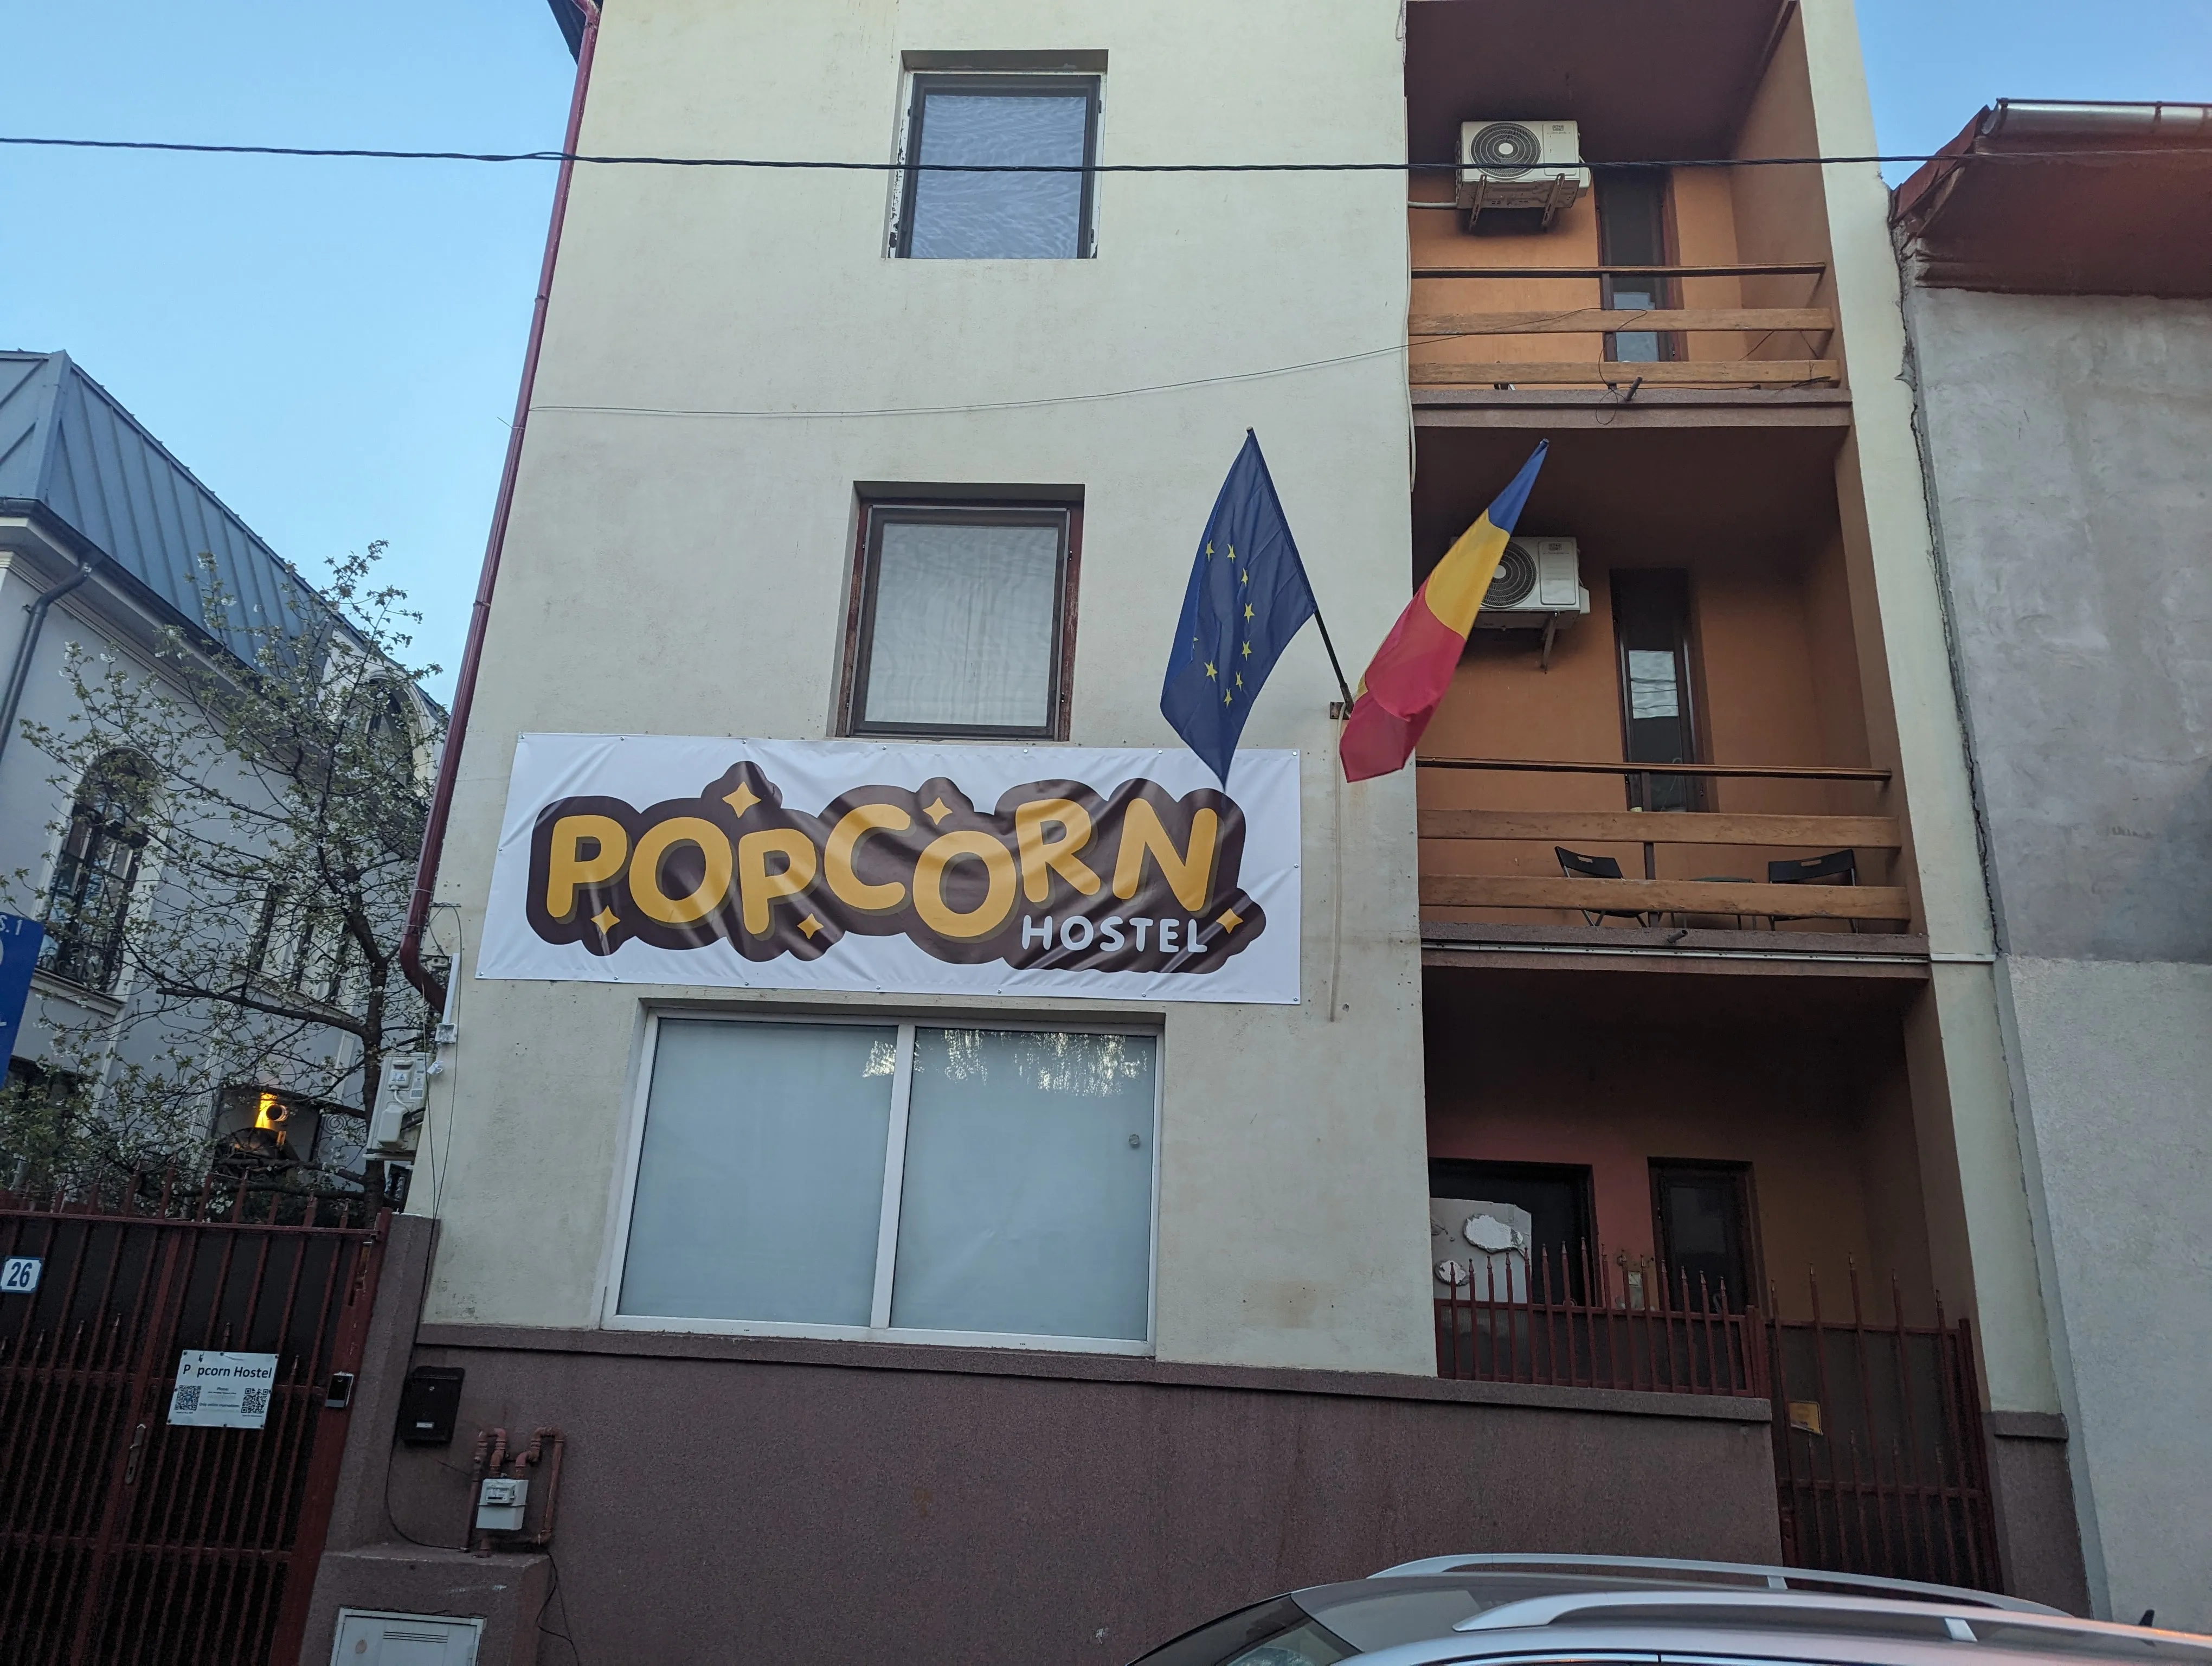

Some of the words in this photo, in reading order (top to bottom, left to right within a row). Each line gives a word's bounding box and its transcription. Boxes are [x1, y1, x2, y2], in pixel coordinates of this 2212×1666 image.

[546, 798, 1218, 939] POPCORN
[1022, 915, 1208, 953] HOSTEL
[7, 1261, 33, 1287] 26
[183, 1364, 230, 1377] Ppcorn
[234, 1366, 272, 1378] Hostel
